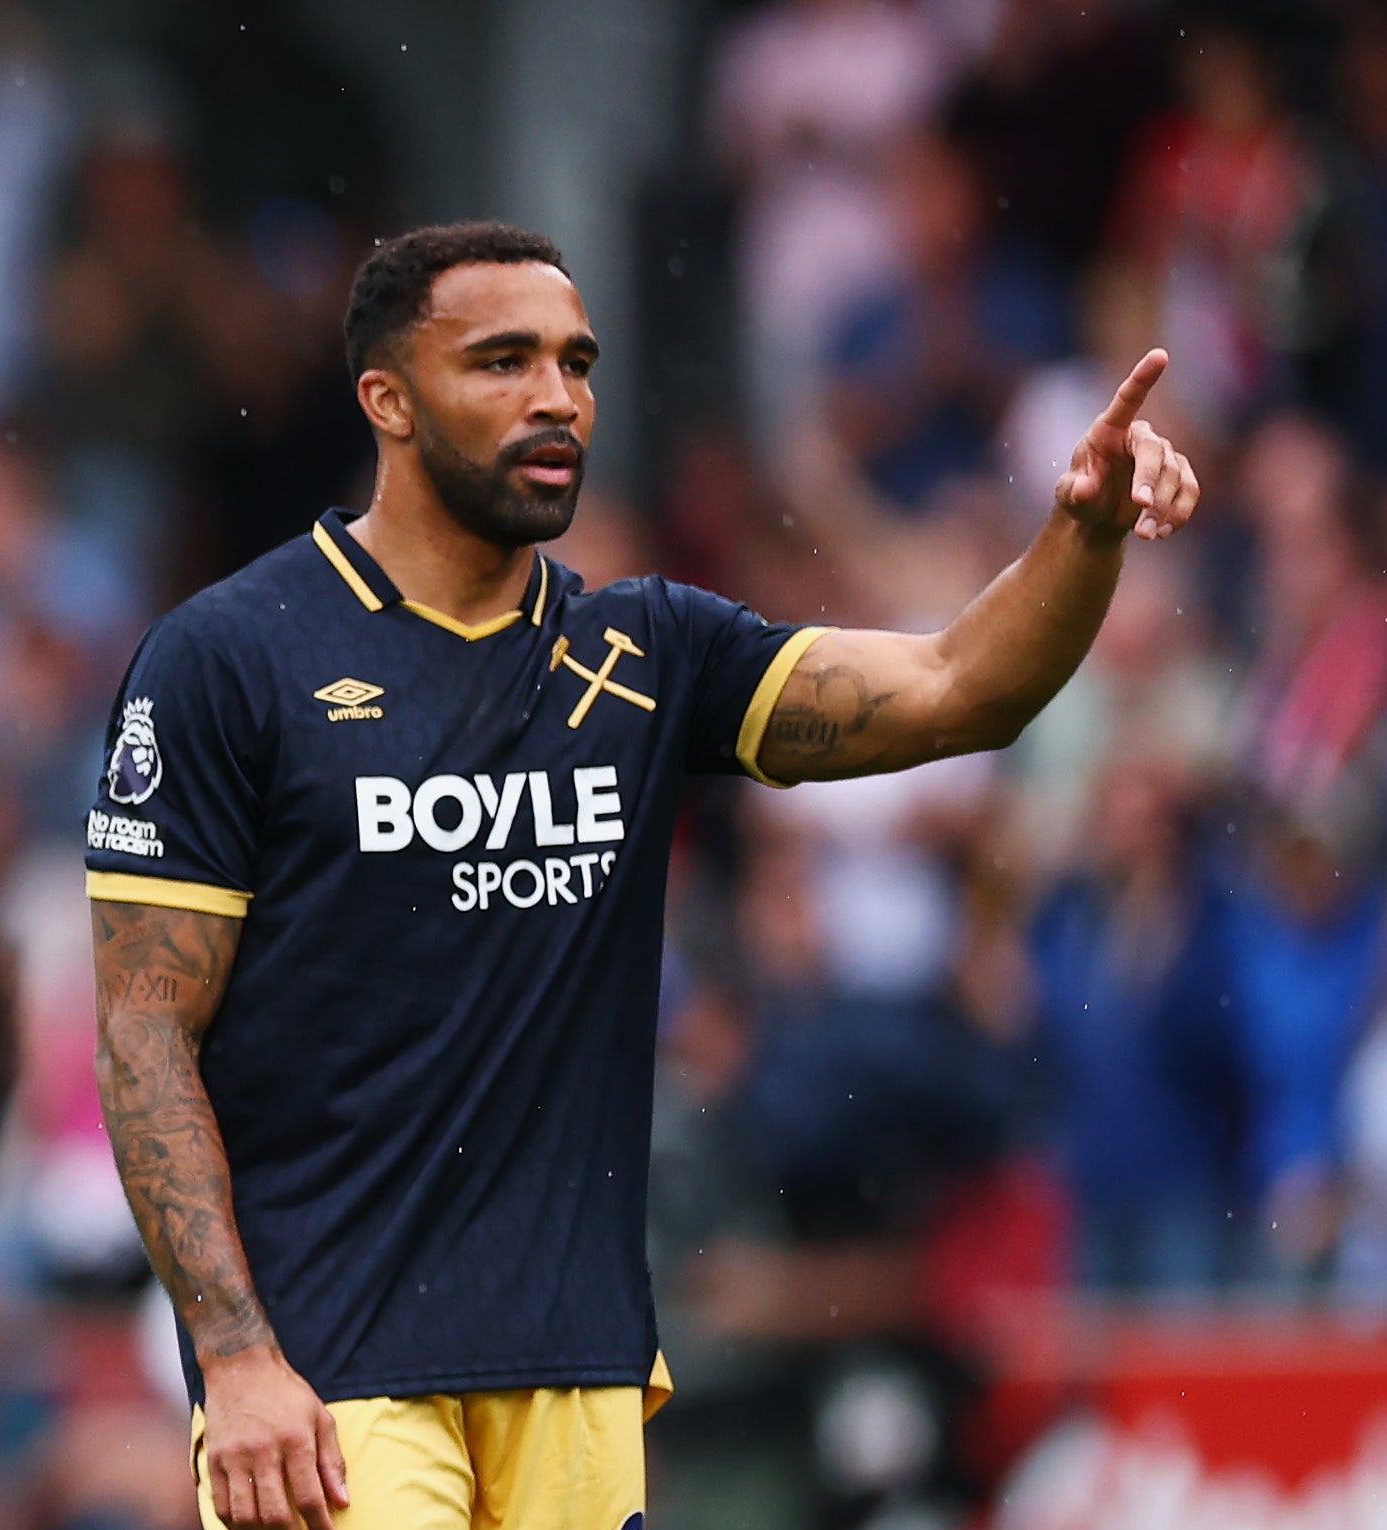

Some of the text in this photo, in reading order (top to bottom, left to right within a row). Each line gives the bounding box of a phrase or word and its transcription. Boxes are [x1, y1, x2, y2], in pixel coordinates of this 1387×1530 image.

[327, 705, 384, 722] umbro
[355, 765, 625, 853] BOYLE
[87, 808, 157, 840] No room
[105, 834, 164, 858] racism
